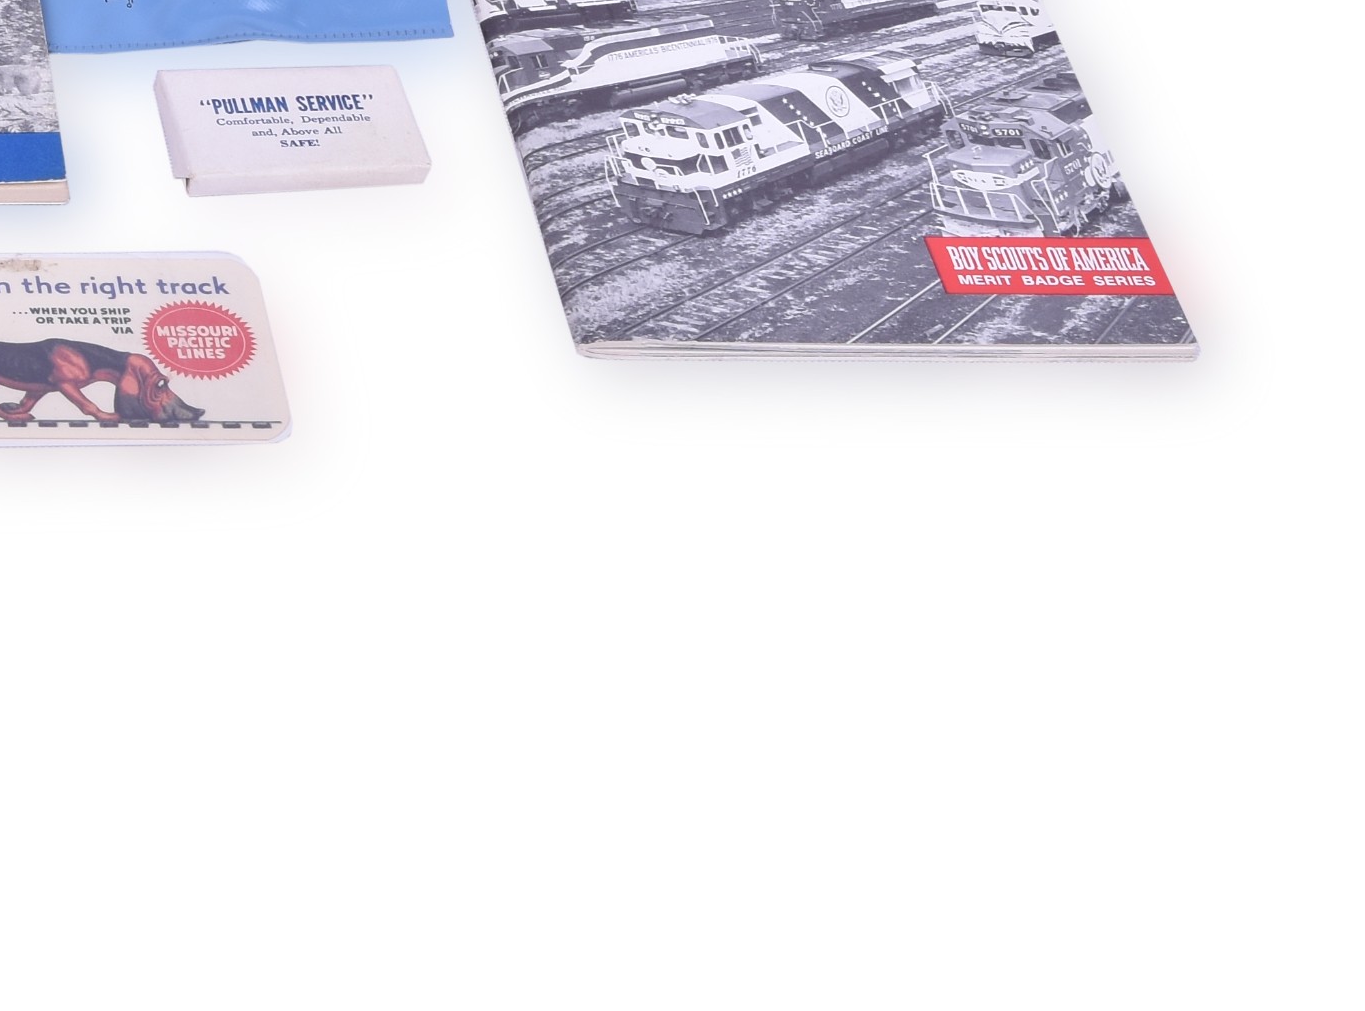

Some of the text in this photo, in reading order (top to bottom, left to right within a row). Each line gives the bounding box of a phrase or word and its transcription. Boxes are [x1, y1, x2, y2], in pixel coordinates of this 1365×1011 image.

[216, 114, 371, 125] Comfortable, Dependable
[279, 139, 321, 147] SAFE!
[946, 246, 1149, 270] BOY SCOUTS OF AMERICA
[957, 275, 1156, 285] MERIT BADGE SERIES
[21, 276, 70, 294] the
[81, 276, 147, 299] right
[156, 276, 230, 294] track
[156, 326, 238, 336] MISSOURI
[166, 336, 231, 348] PACIFIC
[176, 349, 226, 359] LINES
